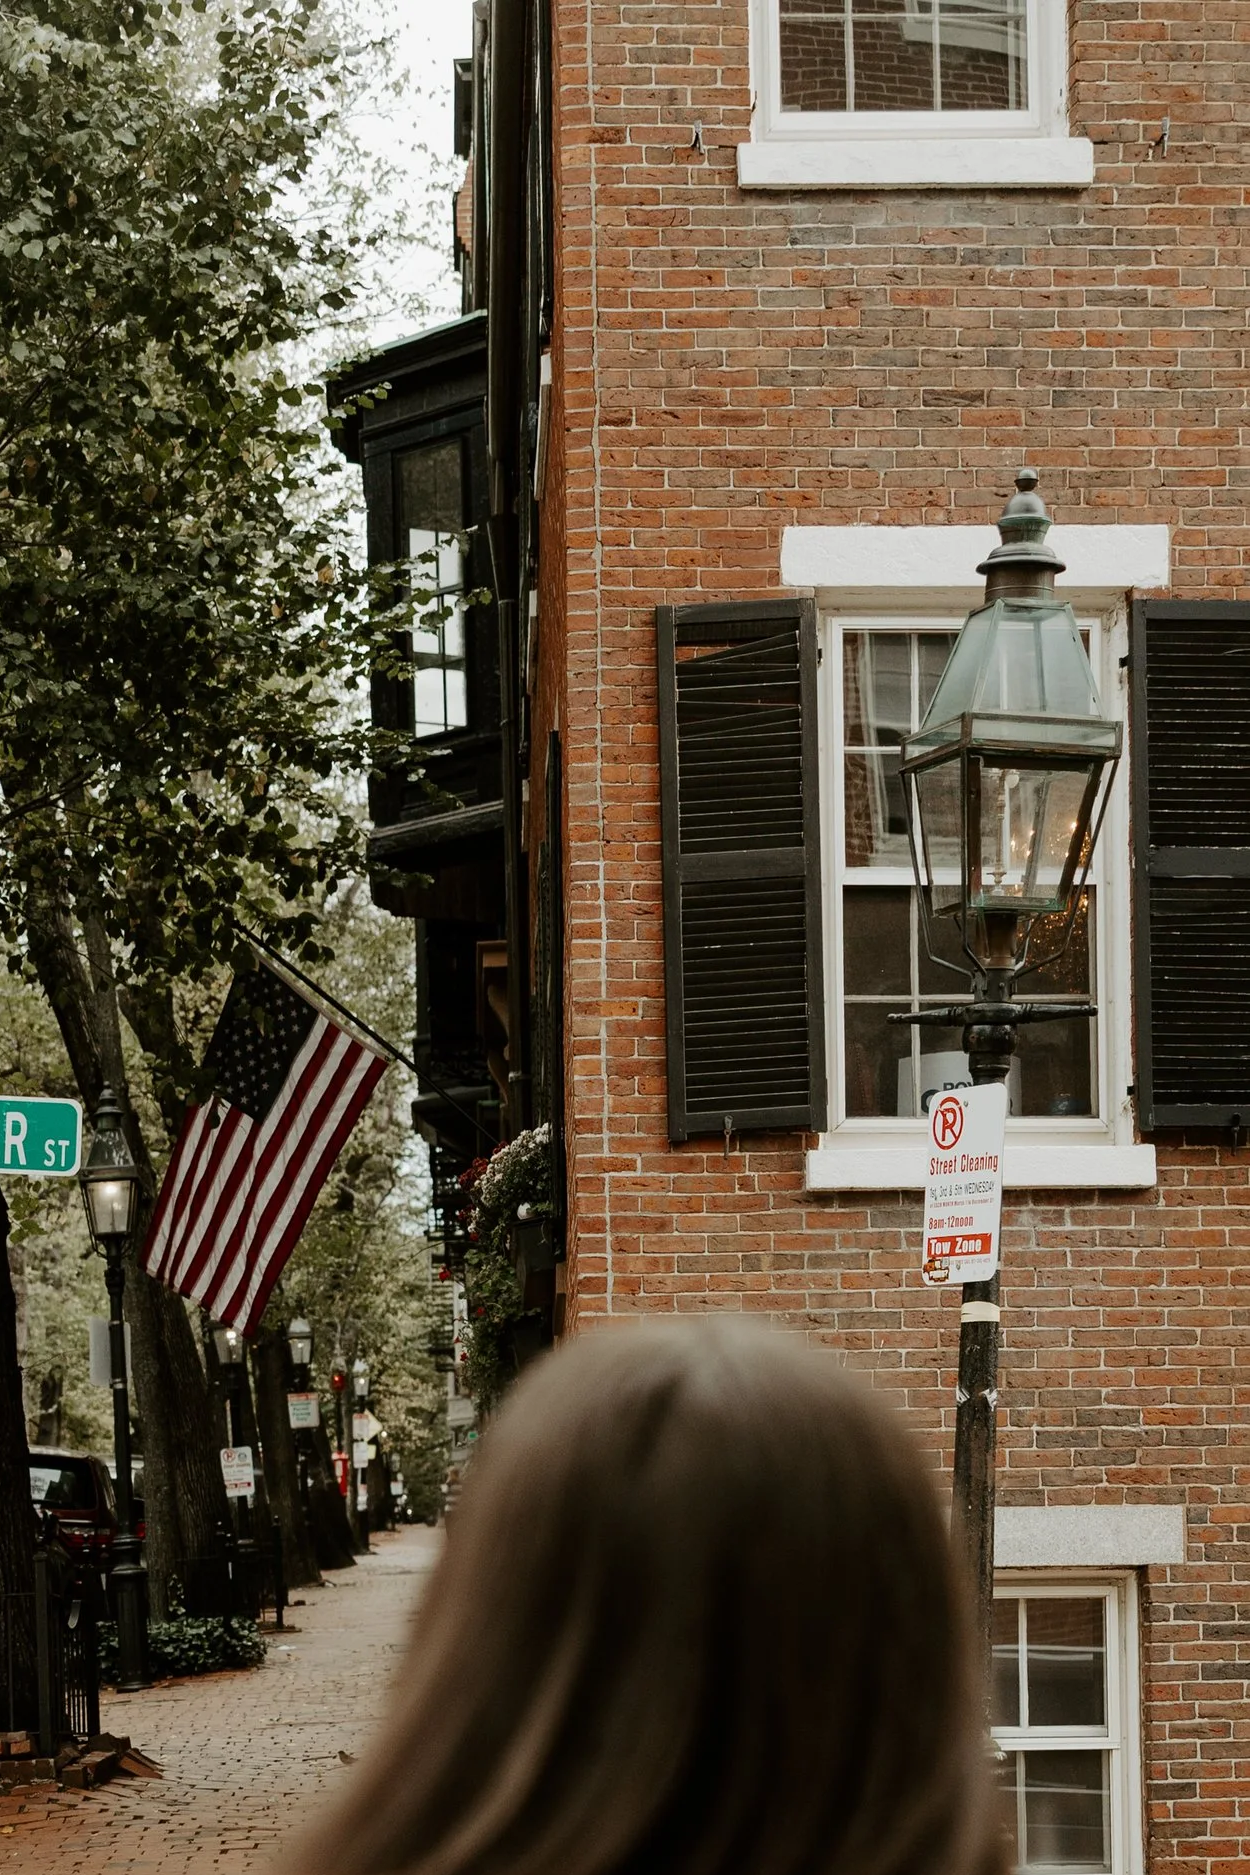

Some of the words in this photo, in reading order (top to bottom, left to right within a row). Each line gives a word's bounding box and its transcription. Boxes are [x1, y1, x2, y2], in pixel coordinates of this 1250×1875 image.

[43, 1139, 70, 1167] ST
[930, 1155, 957, 1175] Street
[961, 1152, 999, 1173] Cleaning
[964, 1180, 995, 1195] WEDNESDAY
[929, 1239, 951, 1255] Tow
[955, 1237, 982, 1254] Zone
